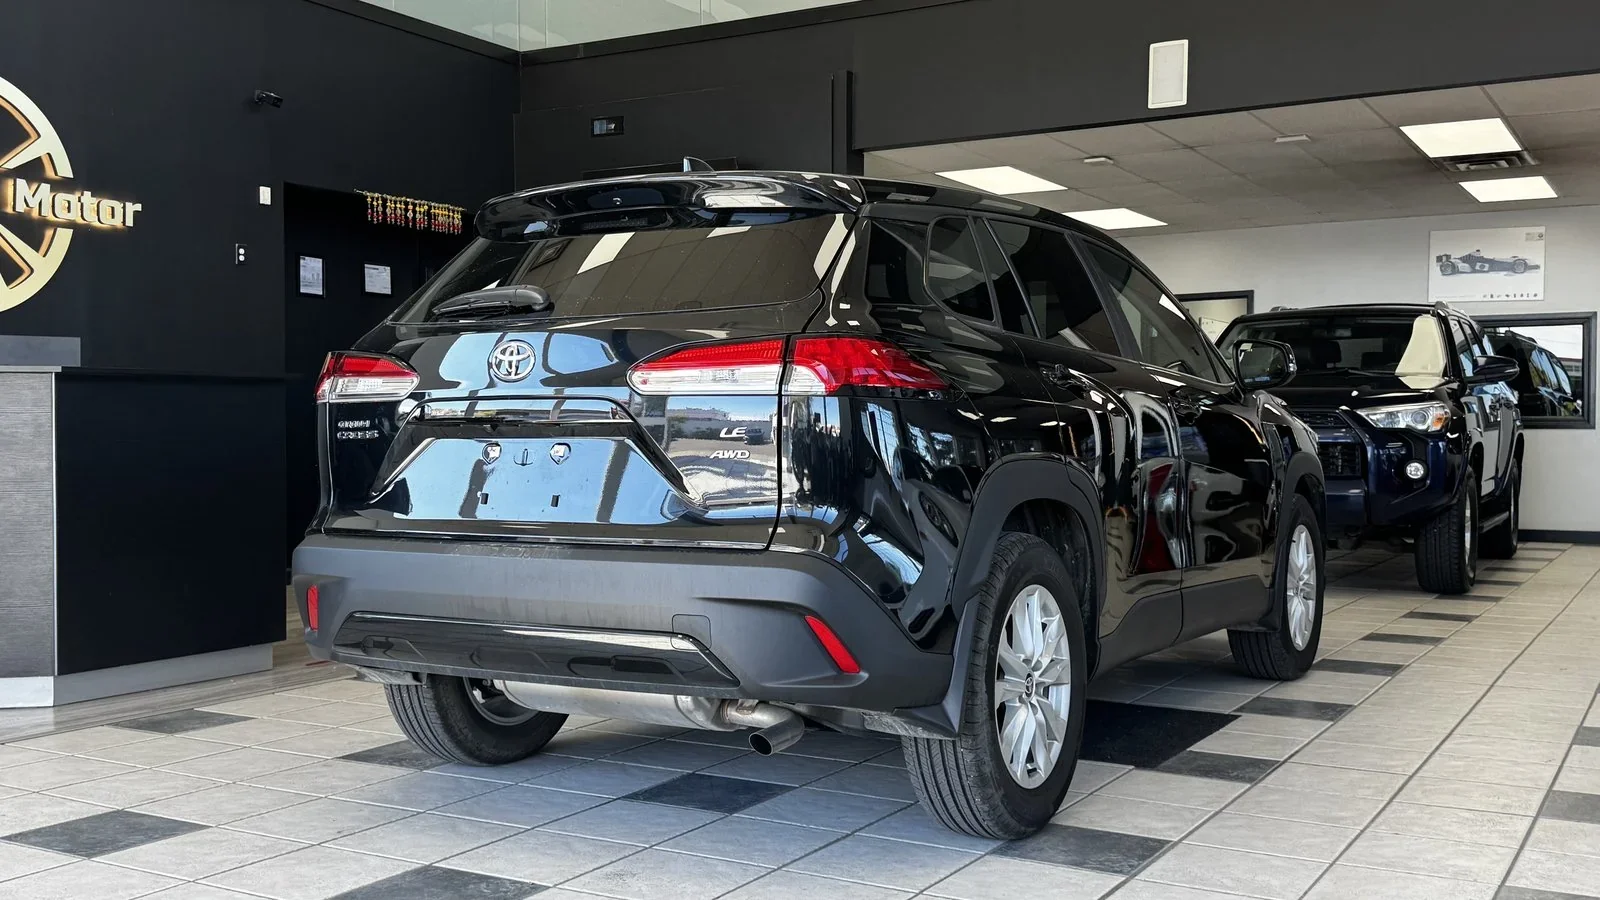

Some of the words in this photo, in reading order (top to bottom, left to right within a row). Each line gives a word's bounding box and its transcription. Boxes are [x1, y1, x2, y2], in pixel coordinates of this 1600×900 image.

[13, 177, 142, 227] Motor
[720, 426, 747, 438] LE
[710, 450, 750, 459] AWD
